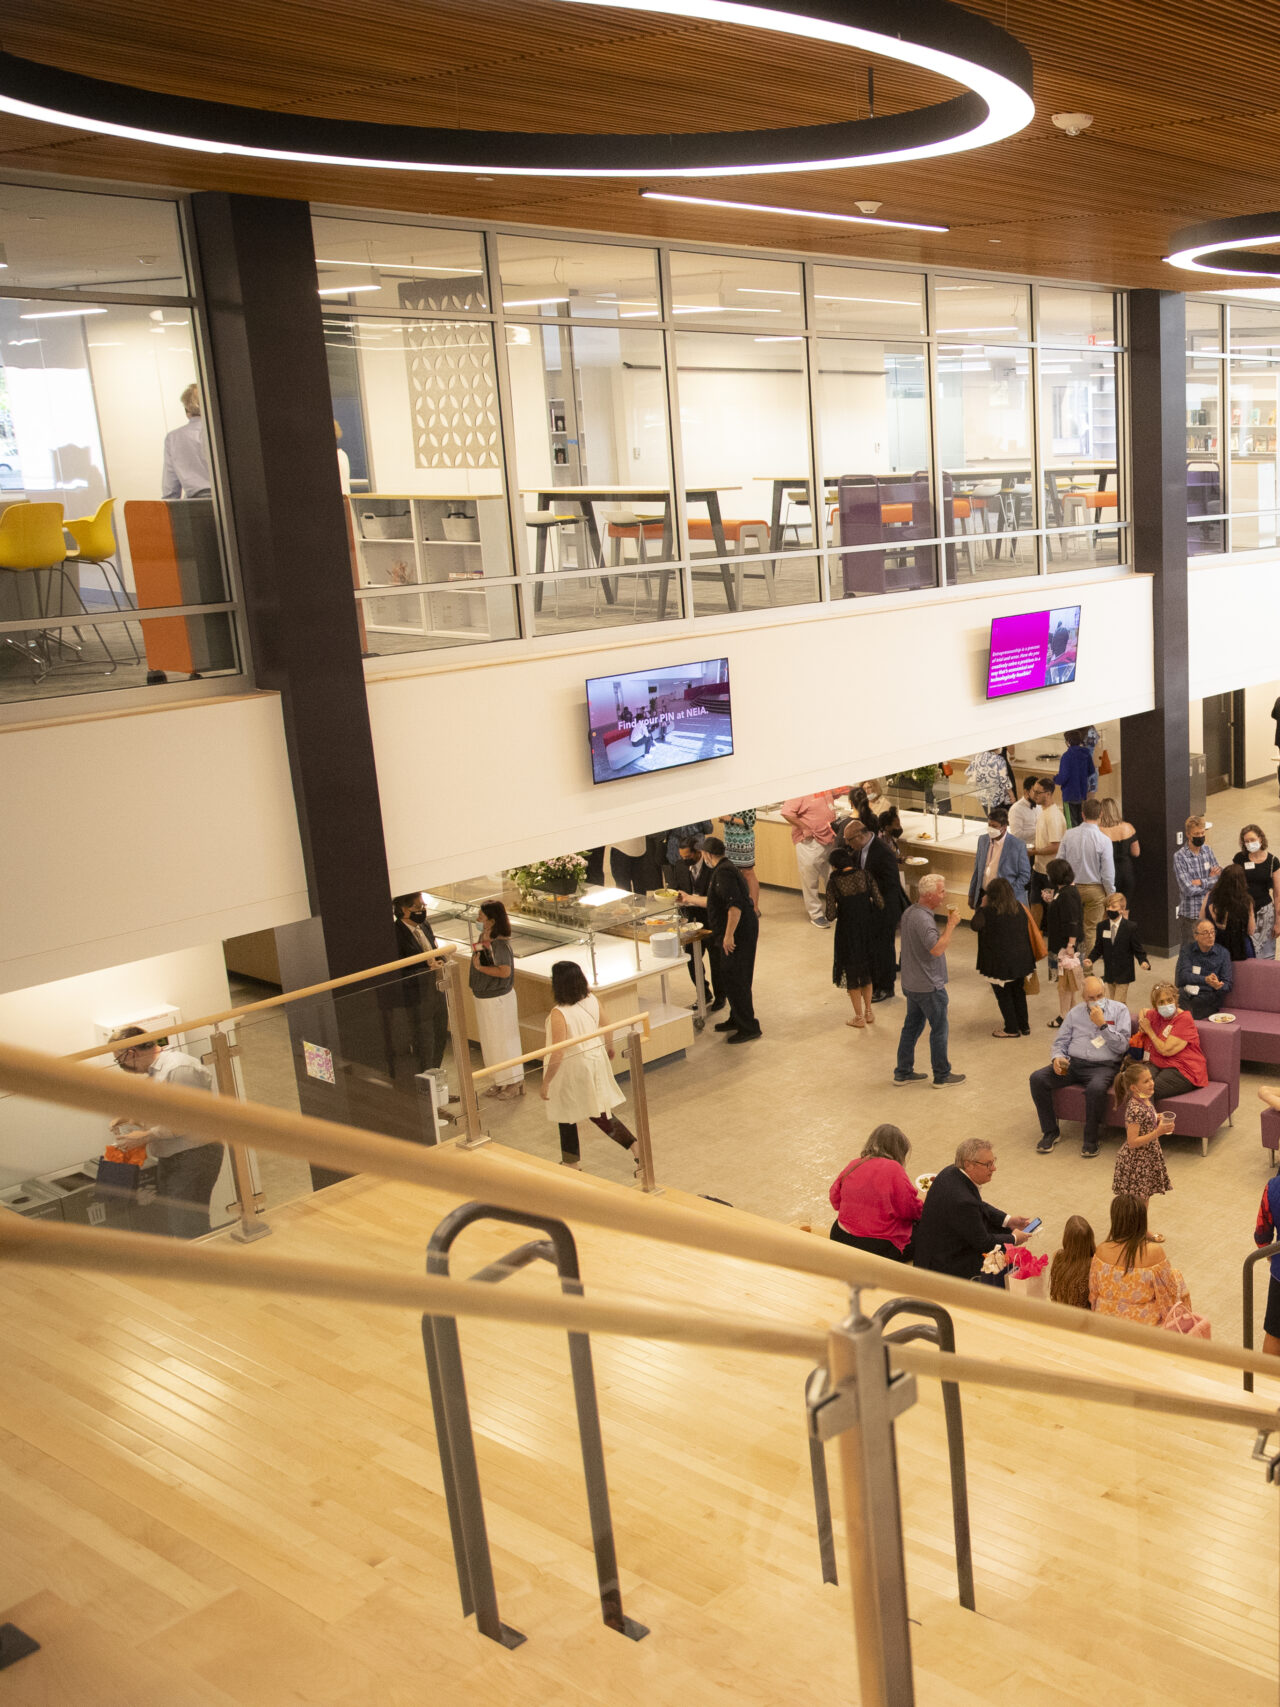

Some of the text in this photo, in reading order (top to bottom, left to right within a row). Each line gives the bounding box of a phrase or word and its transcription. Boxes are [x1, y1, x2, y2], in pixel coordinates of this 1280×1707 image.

[618, 718, 637, 730] Find
[639, 716, 658, 728] your
[659, 712, 675, 723] PIN
[677, 711, 684, 719] at
